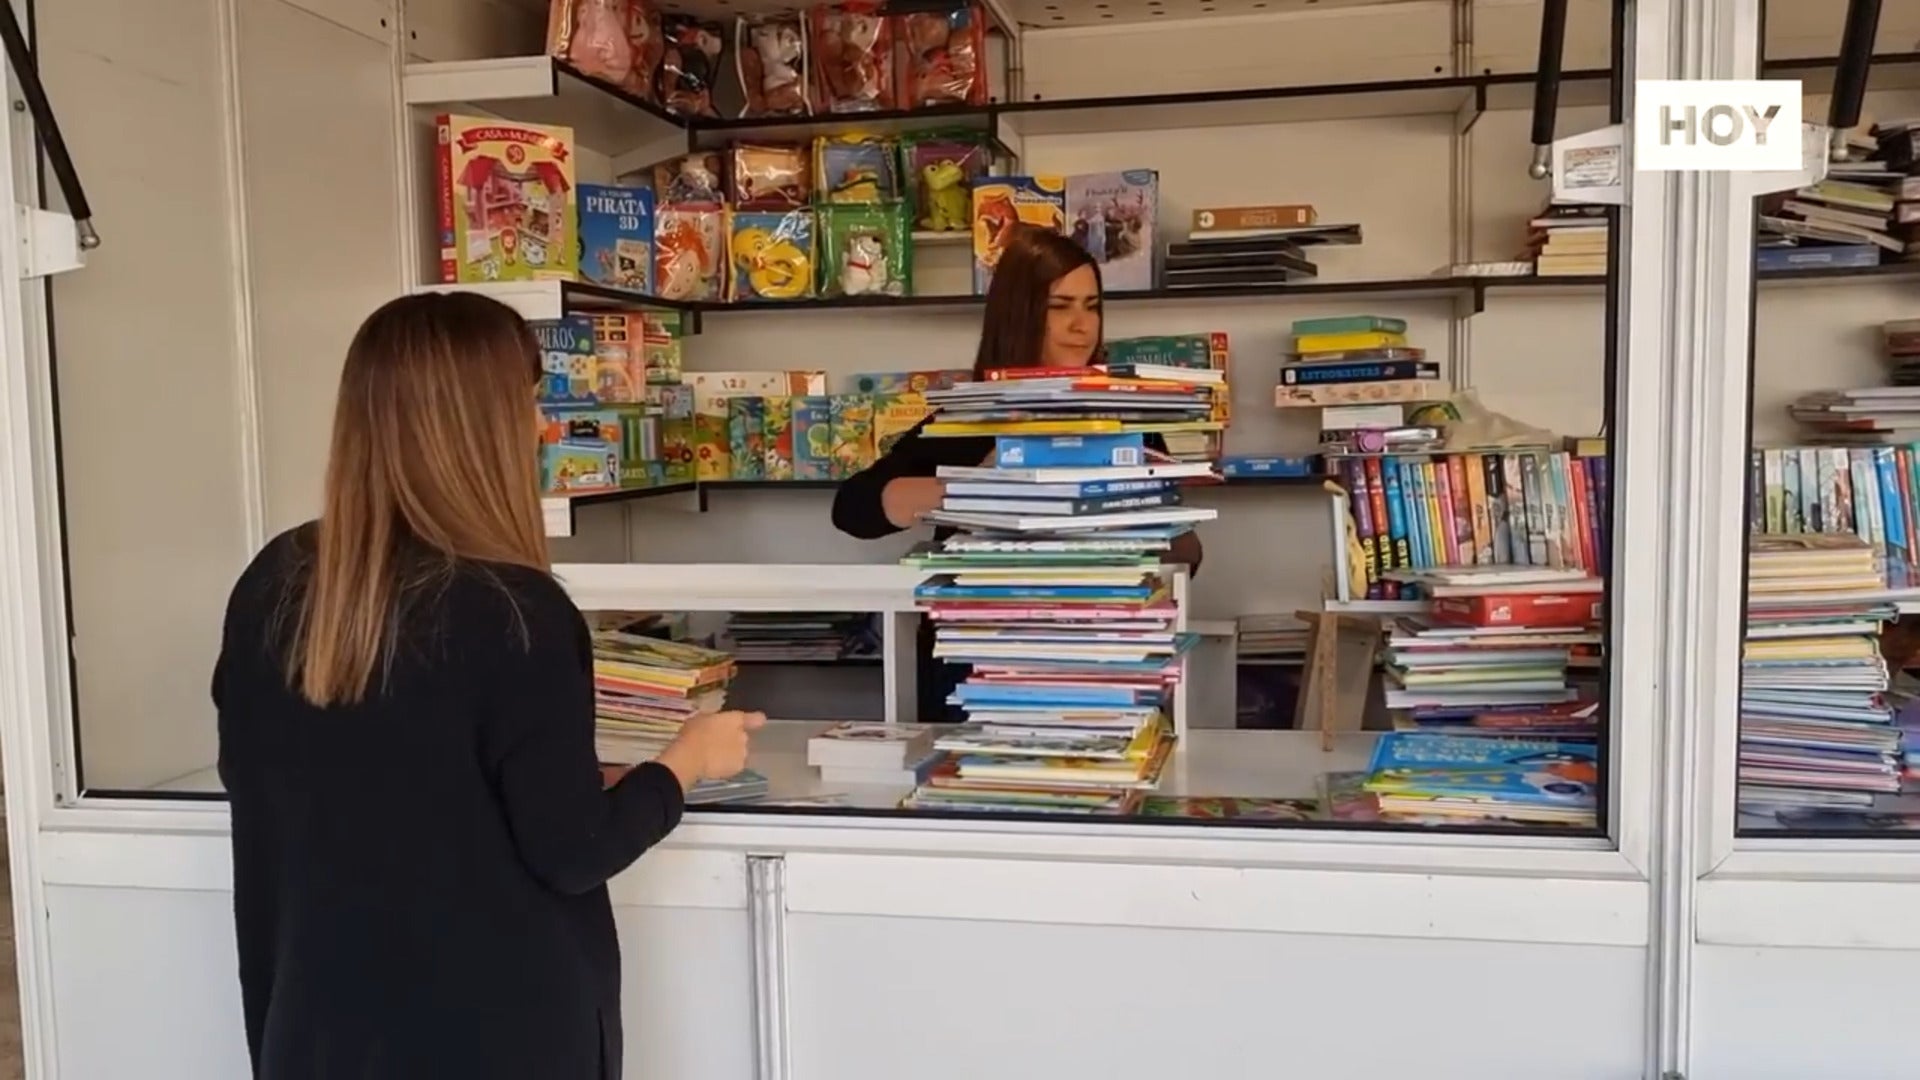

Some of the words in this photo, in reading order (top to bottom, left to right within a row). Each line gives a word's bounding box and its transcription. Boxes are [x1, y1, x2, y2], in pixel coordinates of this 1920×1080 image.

[586, 195, 647, 216] PIRATA
[619, 216, 639, 230] 3D
[535, 327, 576, 349] MEROS
[1301, 366, 1380, 381] ASTRONAUTAS
